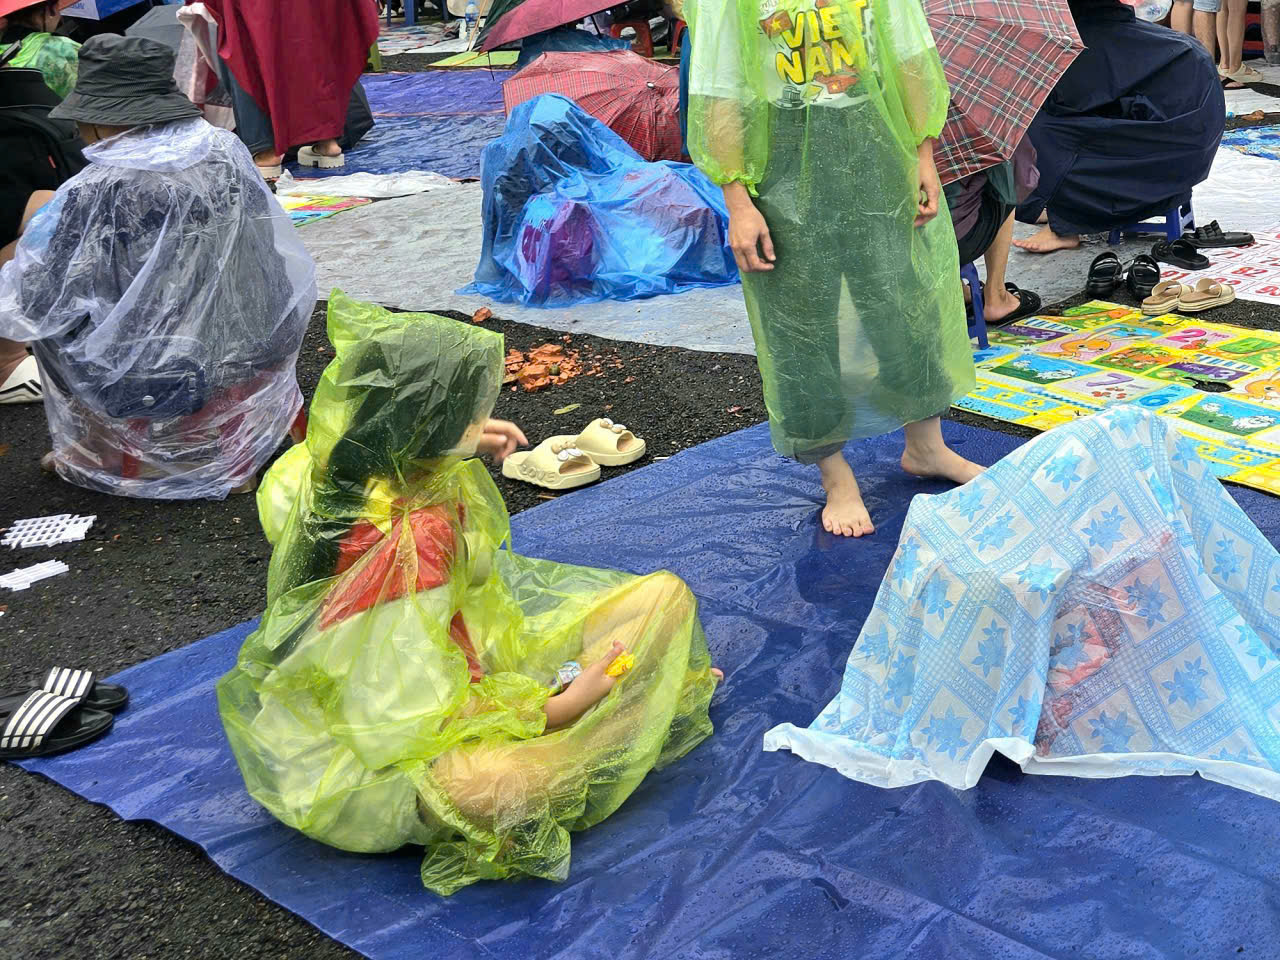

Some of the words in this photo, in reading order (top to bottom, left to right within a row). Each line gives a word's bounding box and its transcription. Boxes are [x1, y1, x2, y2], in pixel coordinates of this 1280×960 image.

[775, 39, 866, 85] NAM
[1231, 266, 1268, 277] 82
[1167, 328, 1206, 343] 2
[1086, 372, 1134, 388] 7
[1209, 369, 1236, 380] 3
[1139, 393, 1179, 407] 6
[519, 463, 557, 483] LOVE
